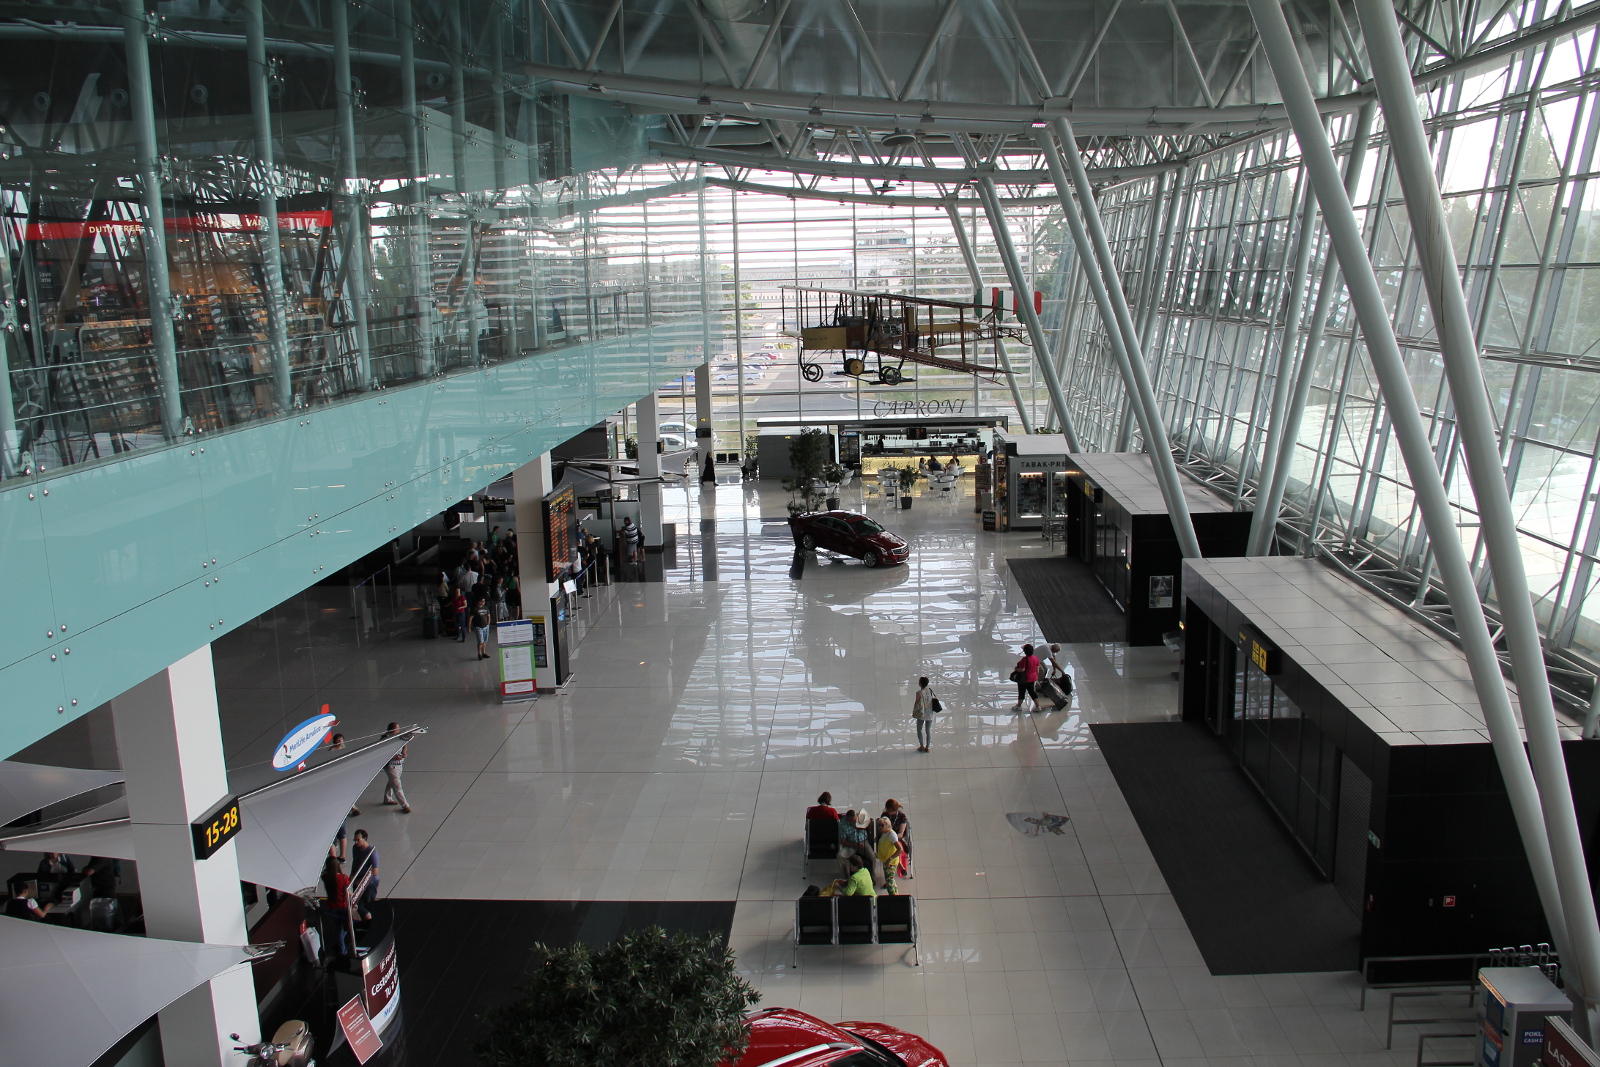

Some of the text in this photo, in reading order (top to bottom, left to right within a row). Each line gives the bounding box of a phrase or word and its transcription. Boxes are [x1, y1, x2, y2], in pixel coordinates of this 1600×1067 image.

[89, 224, 141, 234] DUTY FREE
[873, 398, 967, 417] CAPRONI
[205, 806, 238, 848] 15-28
[1547, 1041, 1572, 1067] LAST
